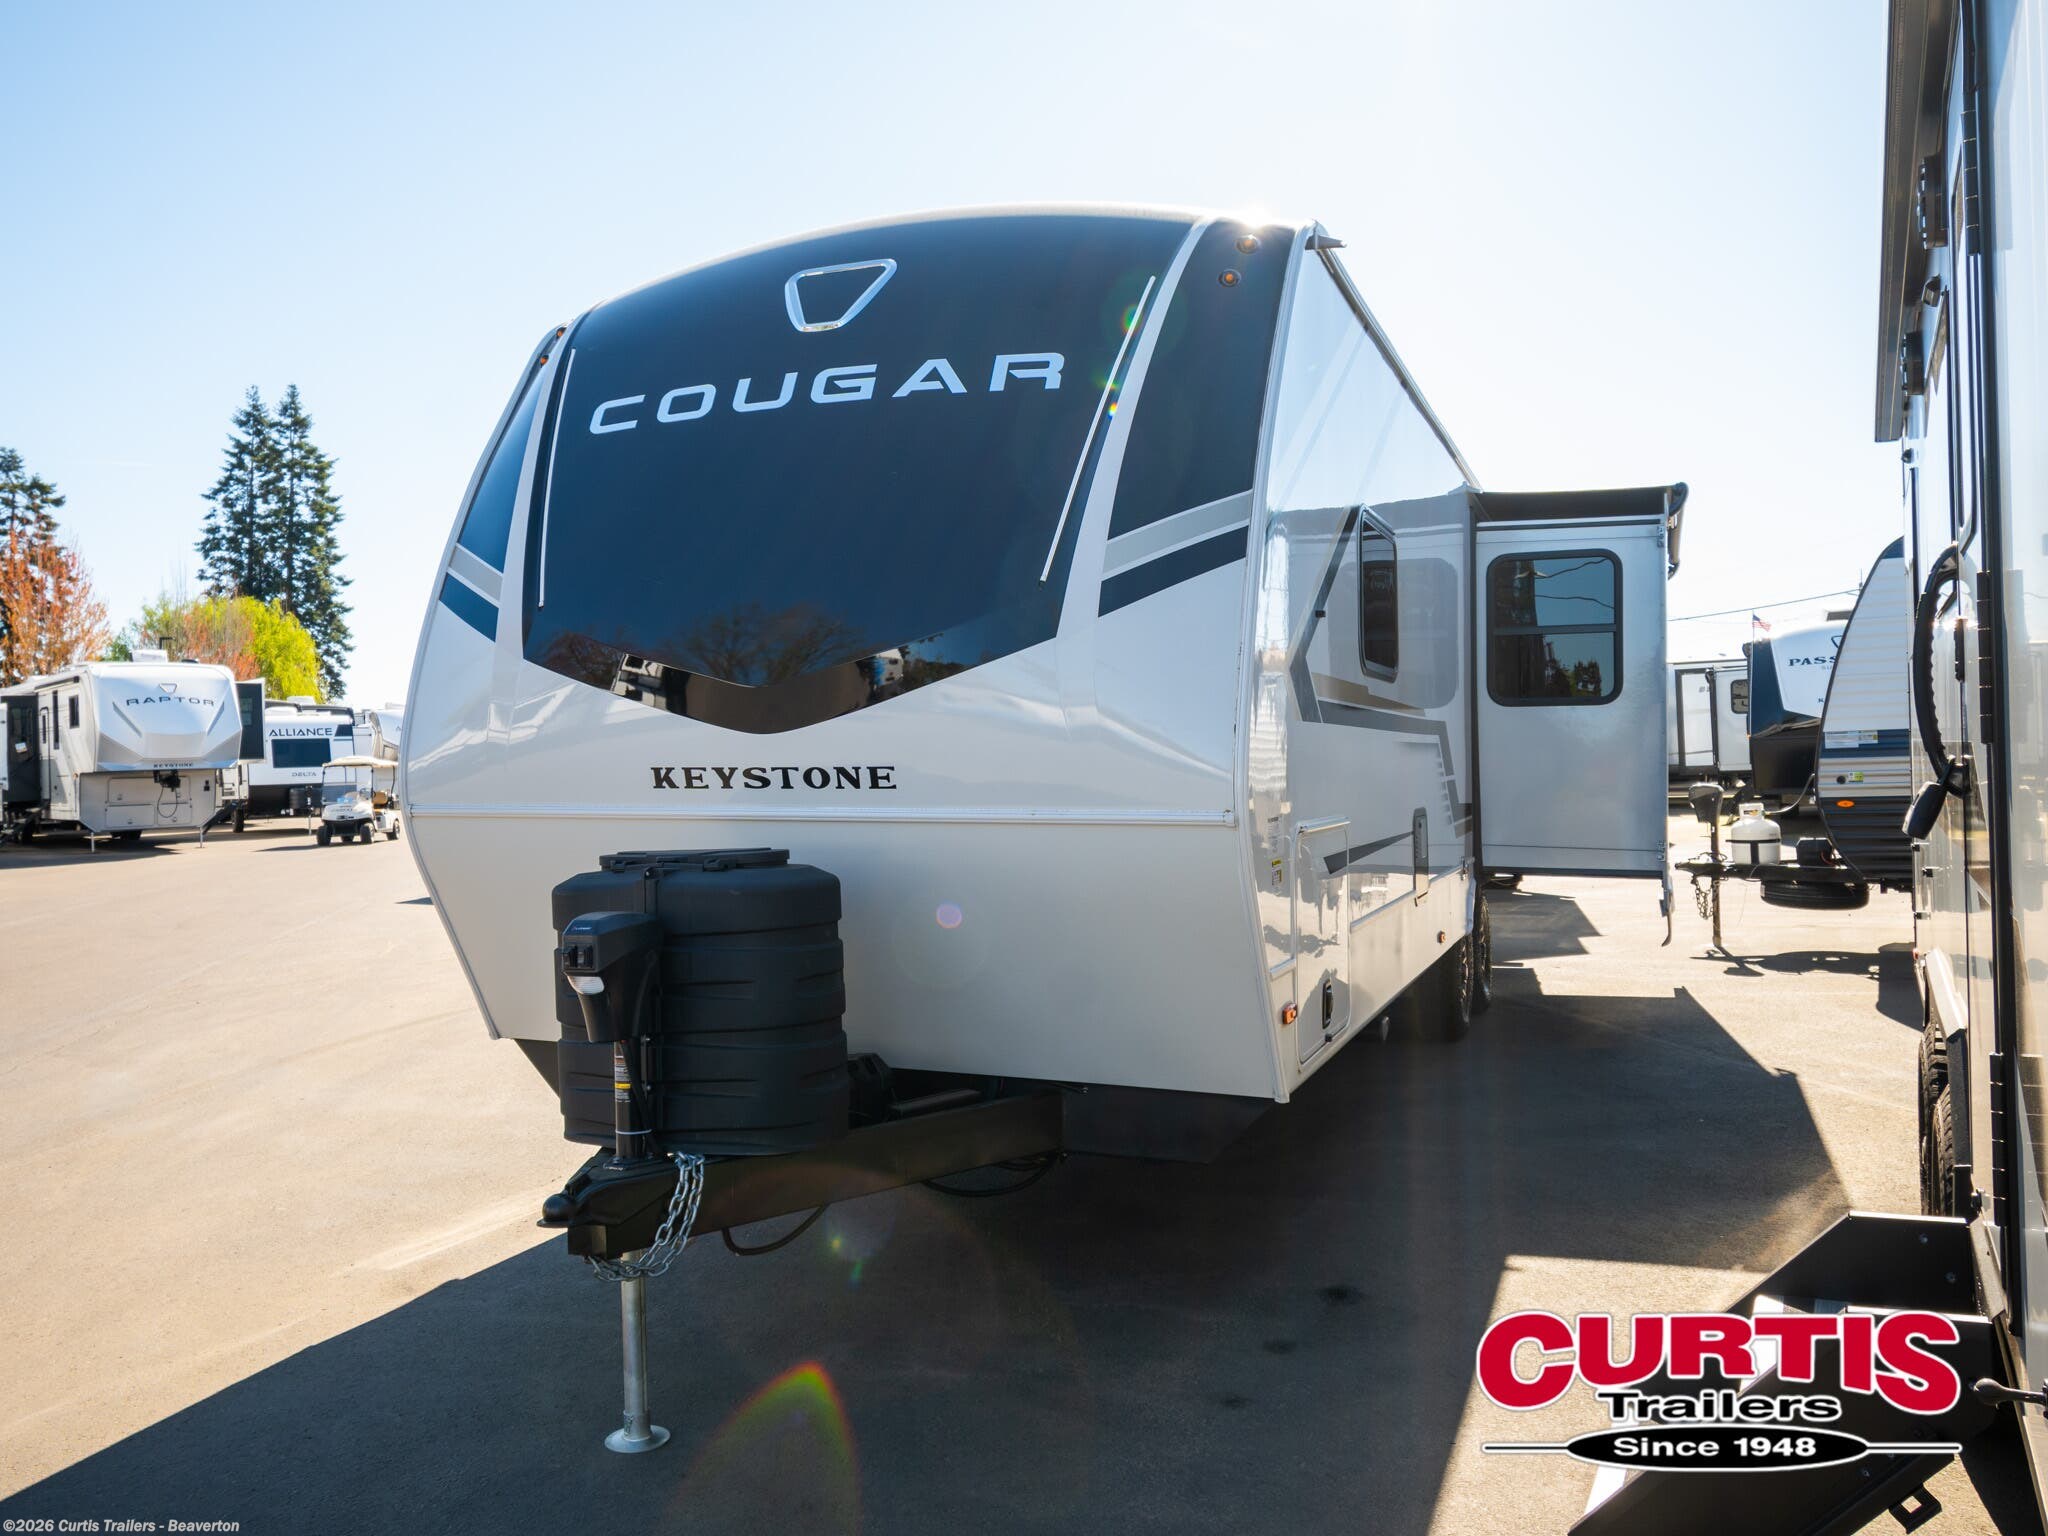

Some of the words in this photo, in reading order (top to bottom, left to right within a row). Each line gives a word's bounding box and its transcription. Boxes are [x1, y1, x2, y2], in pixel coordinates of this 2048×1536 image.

[589, 352, 1066, 435] COUGAR
[125, 695, 215, 707] RAPTOR
[268, 727, 333, 737] ALLIANCE
[650, 766, 897, 790] KEYSTONE
